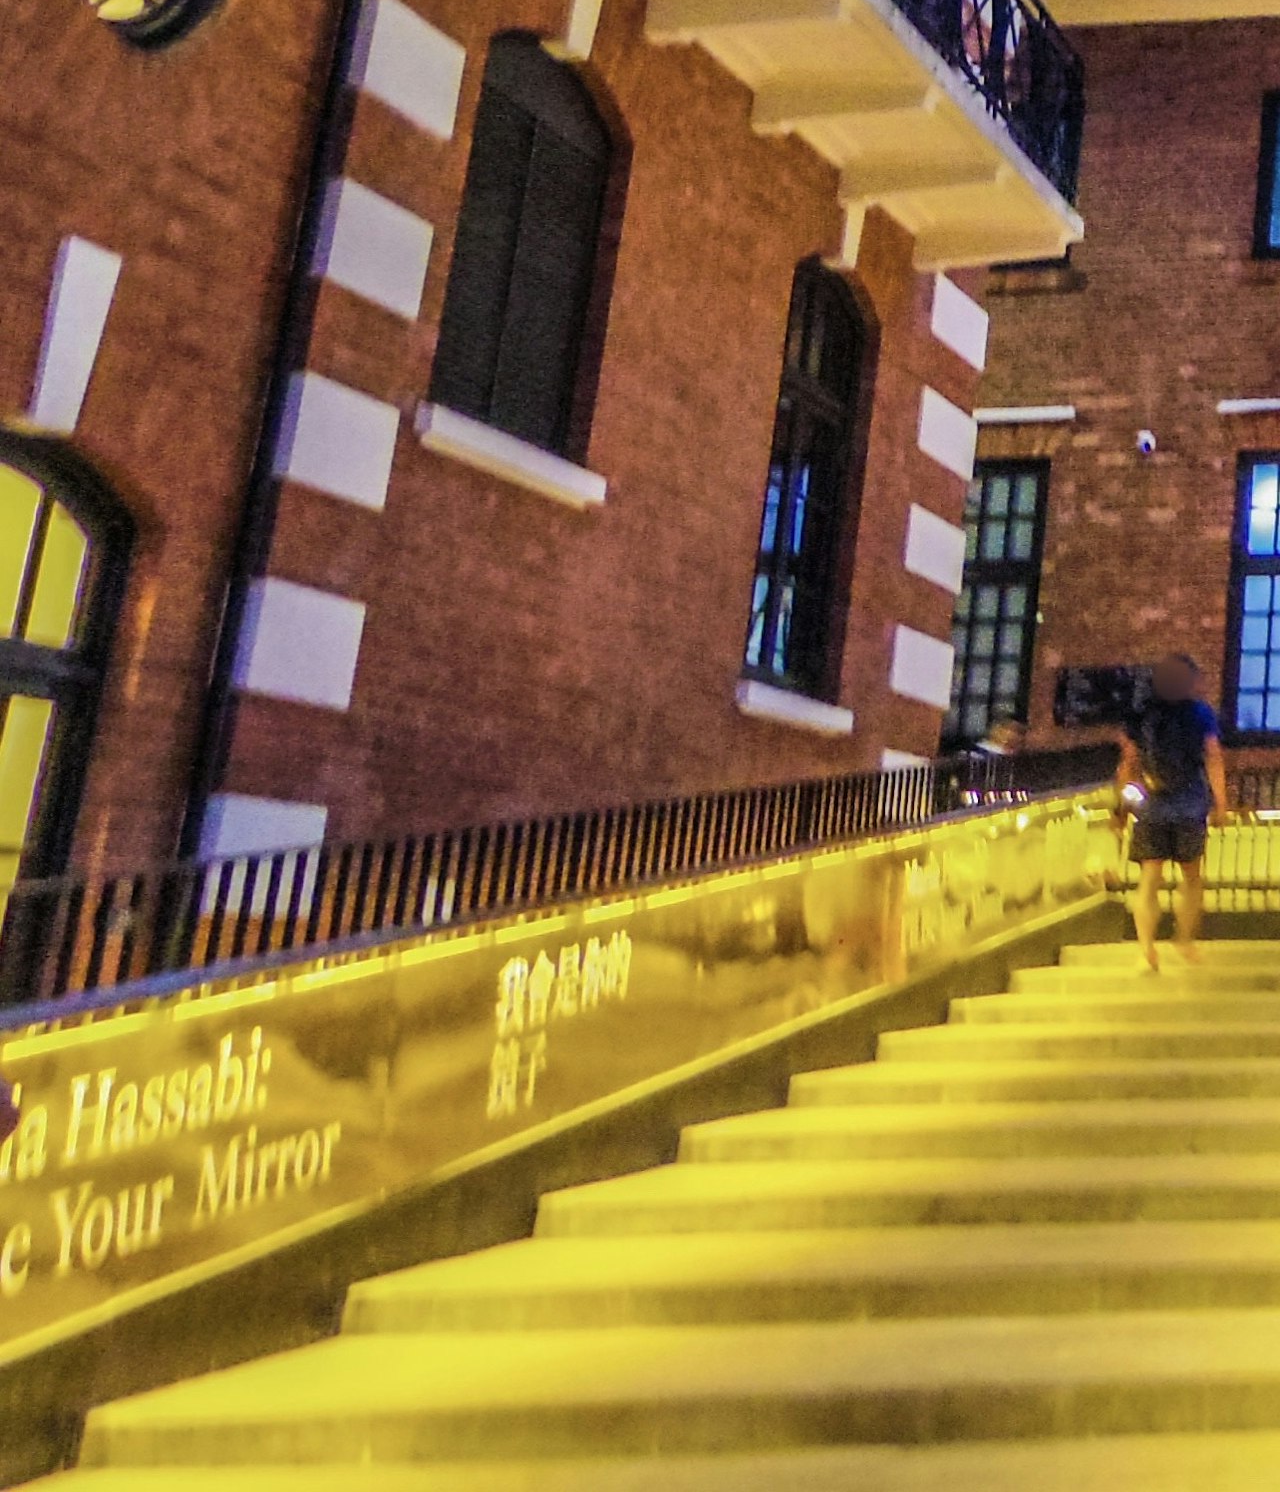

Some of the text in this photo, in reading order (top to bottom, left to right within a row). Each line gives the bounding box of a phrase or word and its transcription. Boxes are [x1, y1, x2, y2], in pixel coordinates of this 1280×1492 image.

[61, 1026, 271, 1164] Hassabi:
[53, 1175, 174, 1278] Your
[192, 1121, 342, 1230] Mirror
